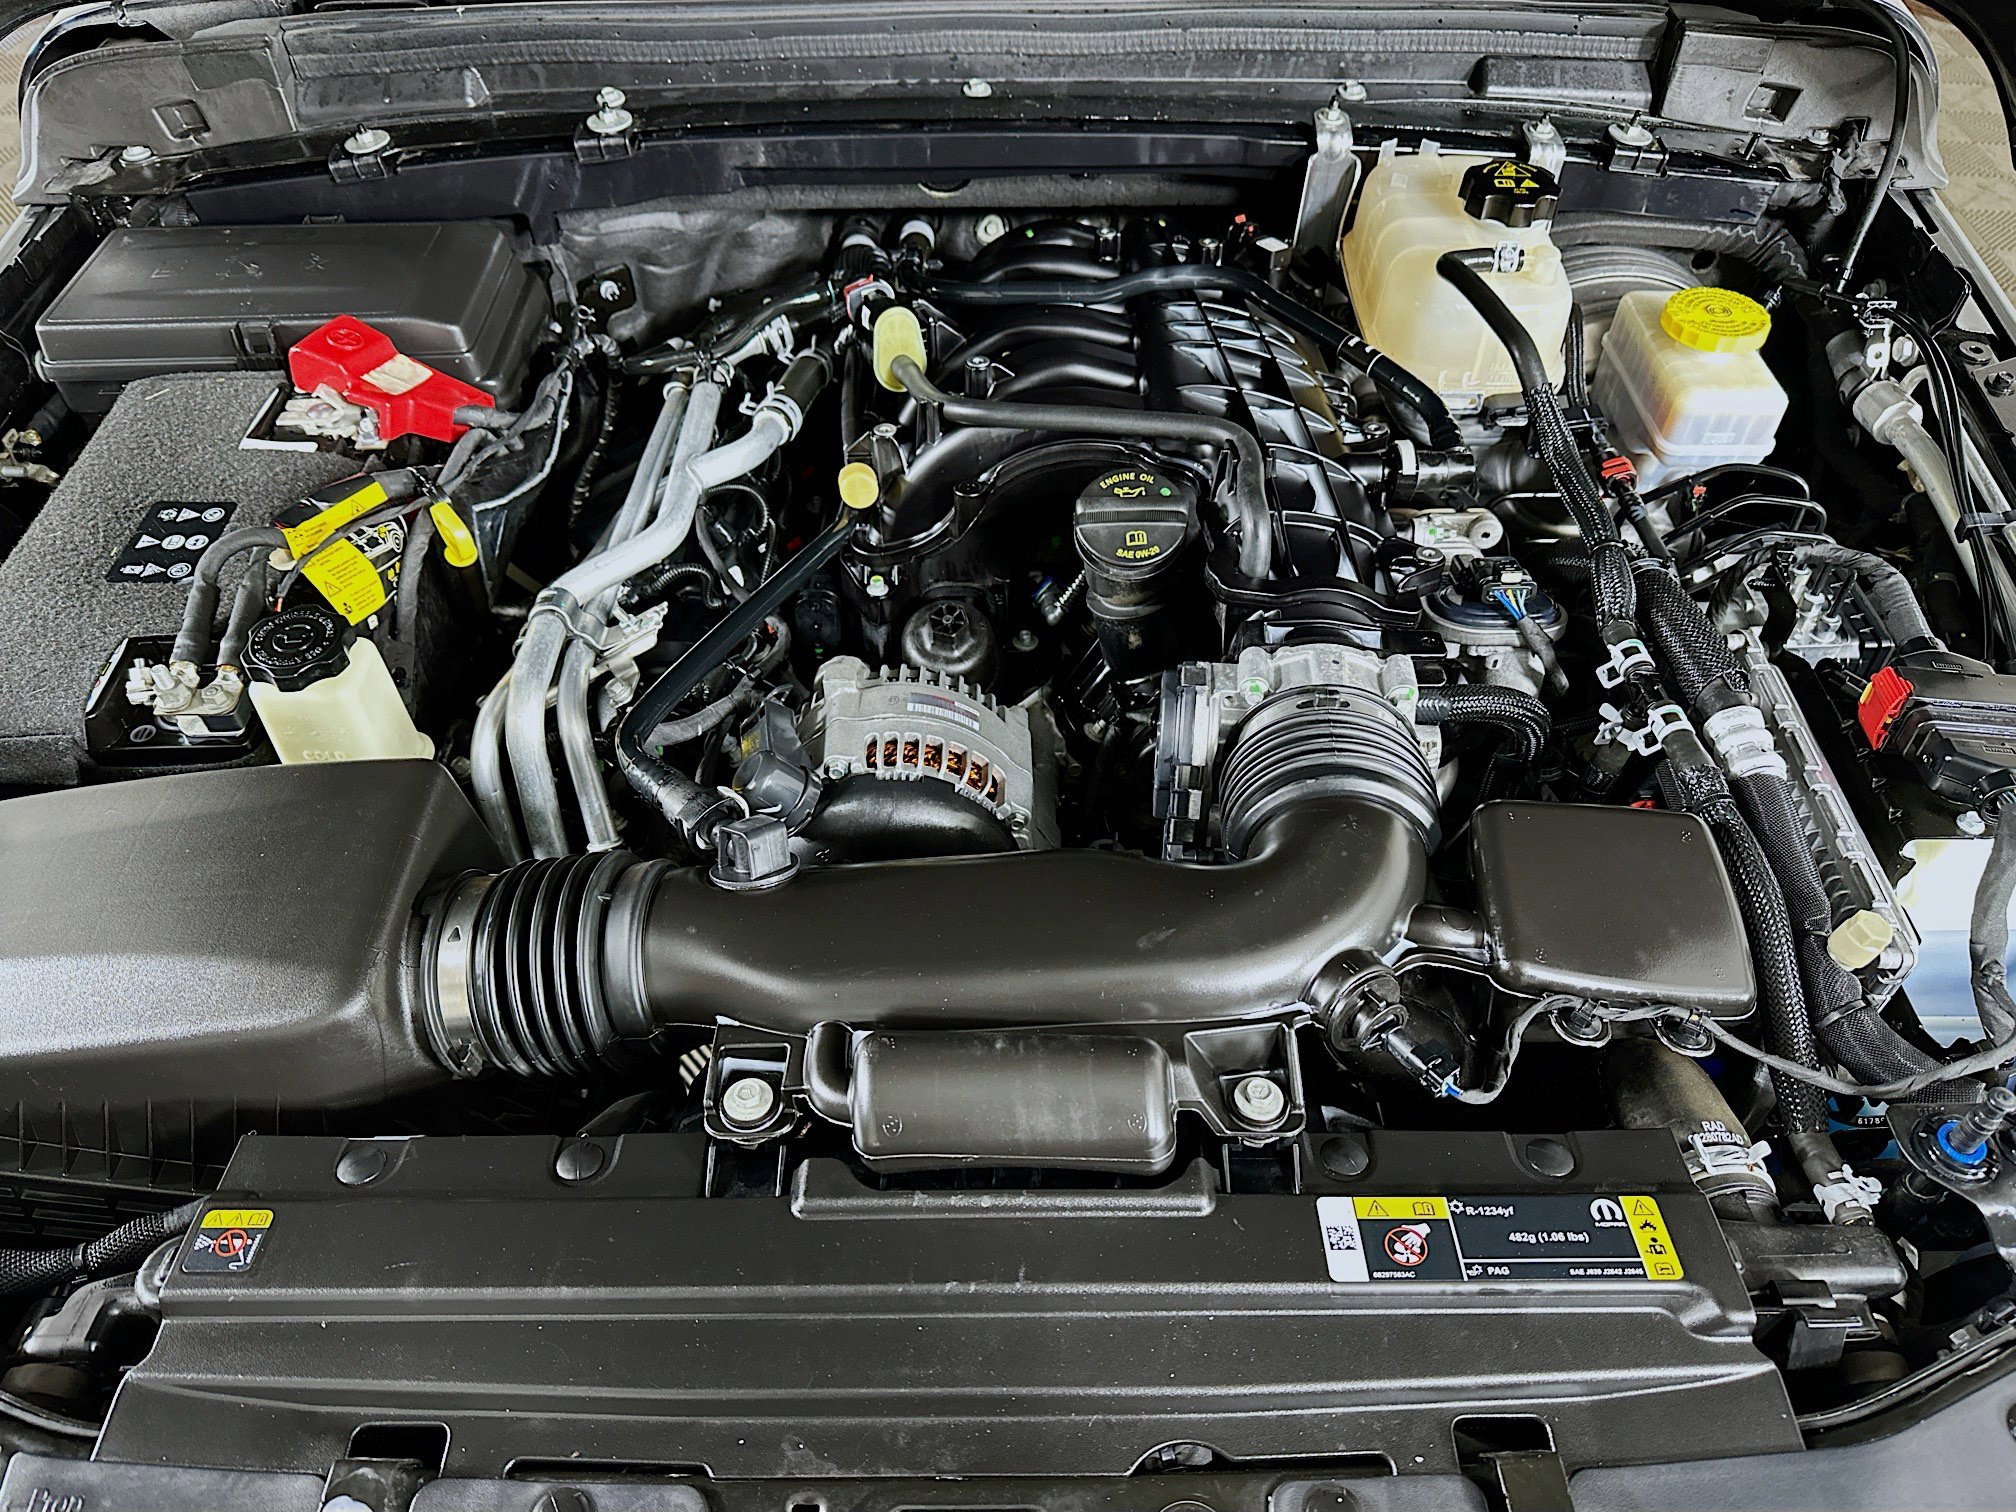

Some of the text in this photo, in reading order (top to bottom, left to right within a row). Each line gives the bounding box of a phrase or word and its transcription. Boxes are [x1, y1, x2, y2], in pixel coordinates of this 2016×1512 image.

[1099, 472, 1154, 489] ENGINE OIL
[1116, 545, 1160, 559] SAE 0W-20
[1701, 1120, 1726, 1132] RAD
[1466, 1206, 1514, 1218] R-1234yf
[1508, 1231, 1590, 1244] 482g (1.06 lbs)
[1487, 1266, 1510, 1276] PAG
[1569, 1268, 1585, 1276] SAE
